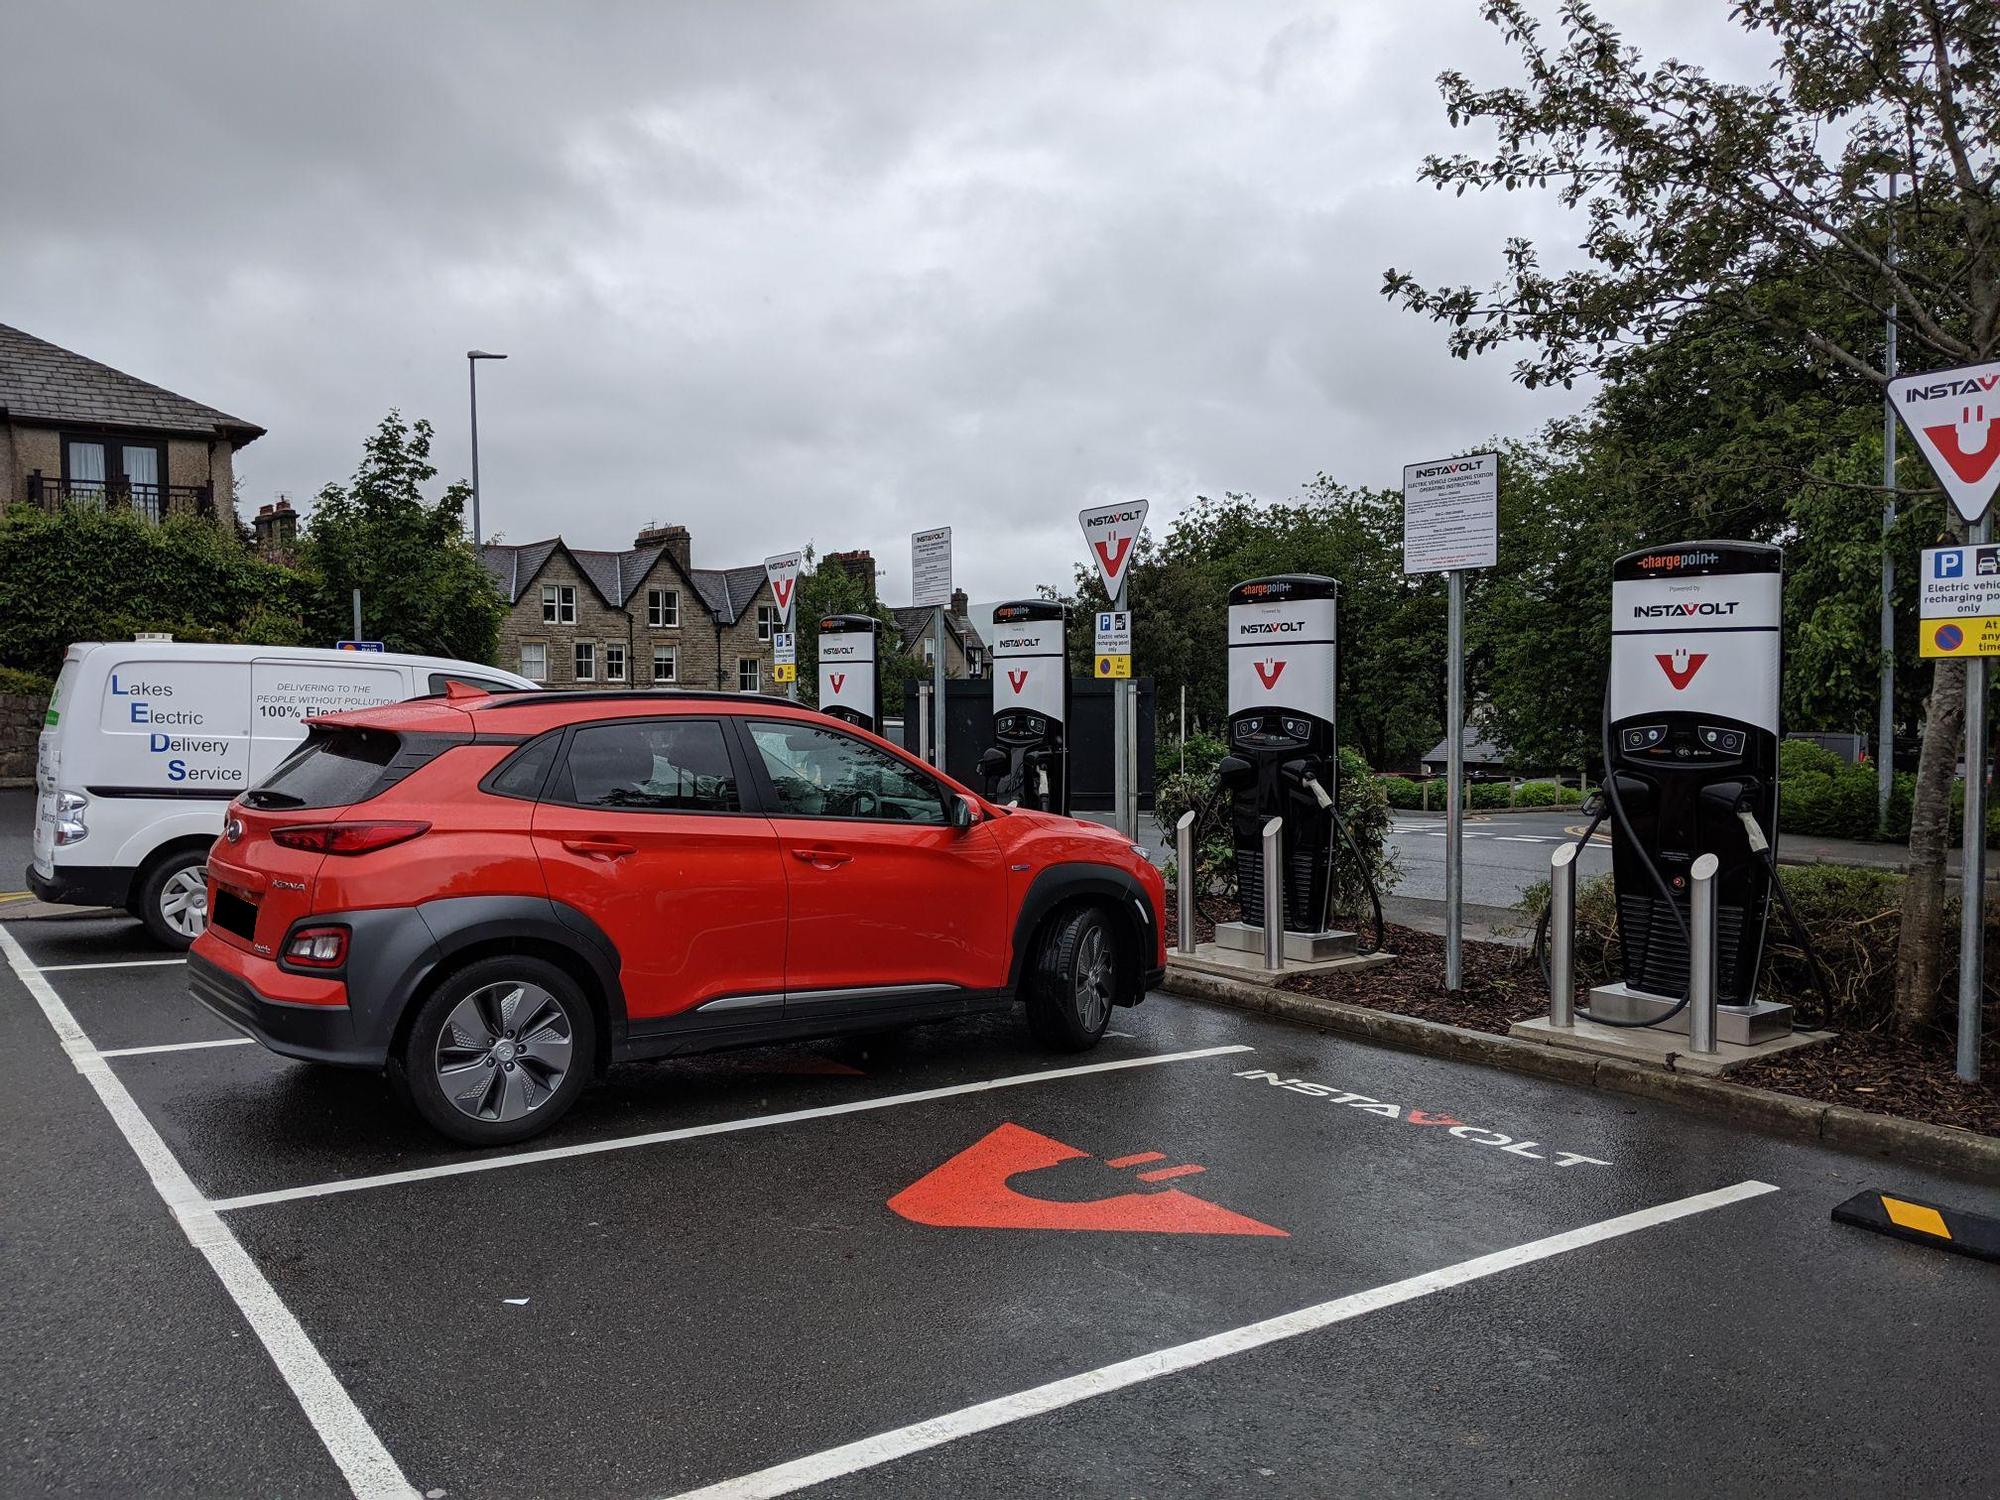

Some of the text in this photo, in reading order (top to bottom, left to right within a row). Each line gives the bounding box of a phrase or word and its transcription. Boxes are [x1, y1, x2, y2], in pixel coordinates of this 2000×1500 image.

[1416, 461, 1484, 479] INSTAVOLT
[1087, 509, 1142, 528] INSTAVOLT
[1941, 553, 1959, 576] P
[1928, 583, 1970, 593] Electric
[1924, 593, 1983, 604] recharging
[1634, 601, 1740, 618] INSTAVOLT
[1957, 603, 1981, 613] only
[1240, 621, 1305, 634] INSTAVOLT
[1985, 620, 1998, 629] At
[1981, 633, 2000, 641] any
[1978, 643, 2000, 652] time
[112, 675, 173, 696] Lakes
[276, 682, 371, 694] DELIVERING TO THE
[256, 694, 296, 704] PEOPLE
[298, 695, 344, 705] WITHOUT
[130, 702, 204, 725] Electric
[259, 705, 301, 718] 100%
[150, 733, 229, 756] Delivery
[167, 759, 242, 781] Service
[1231, 1069, 1614, 1168] INSTAVOLT
